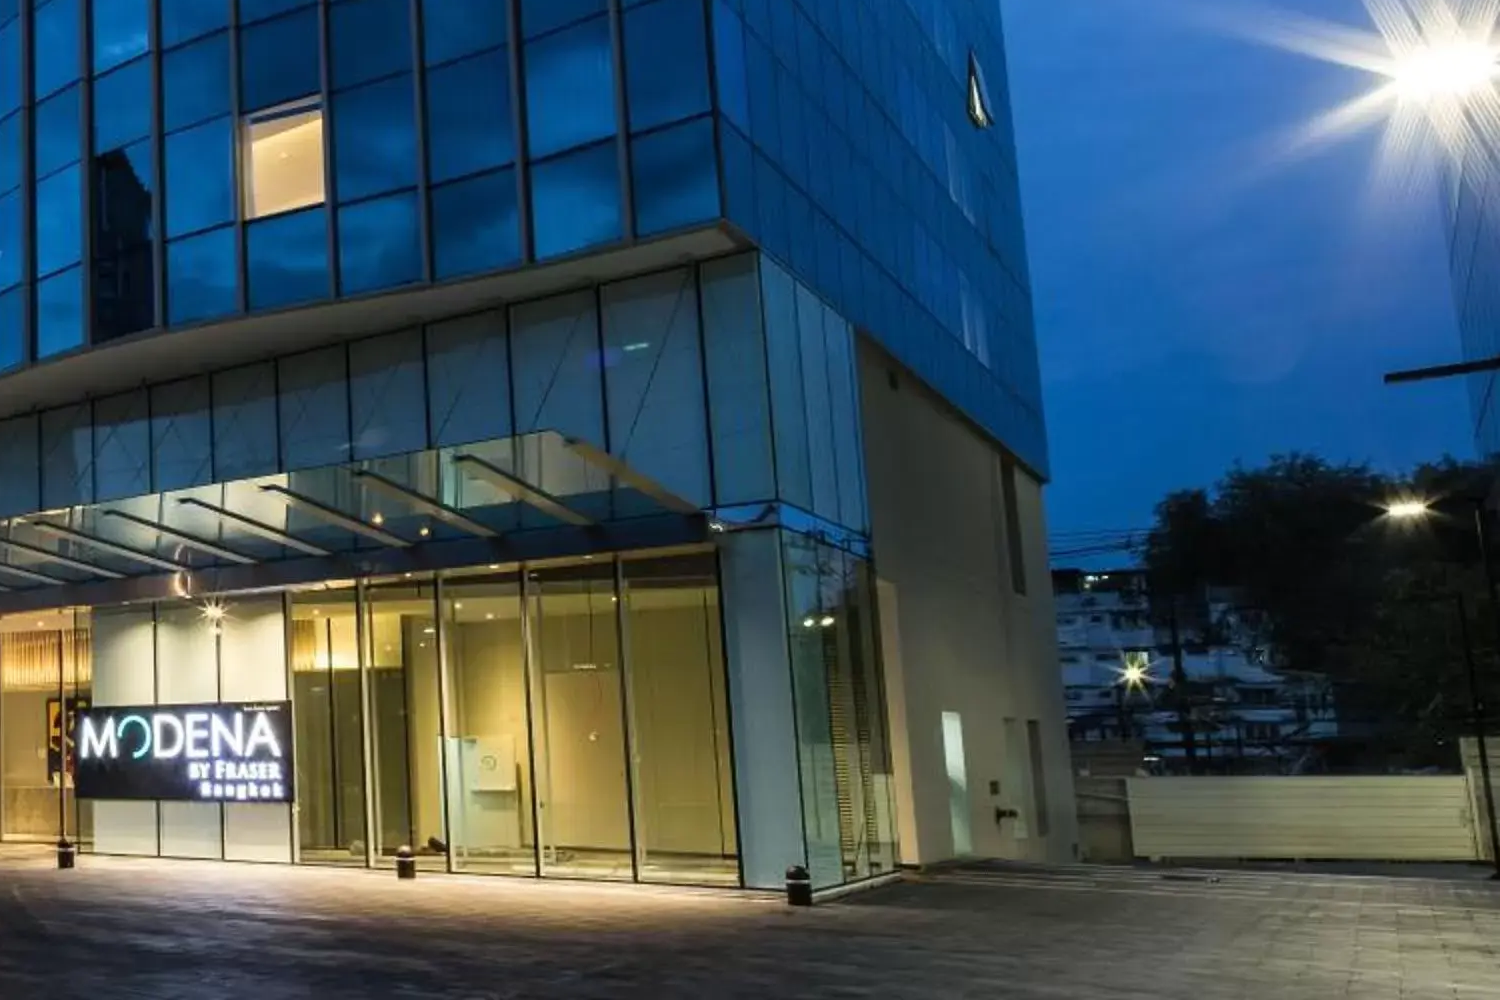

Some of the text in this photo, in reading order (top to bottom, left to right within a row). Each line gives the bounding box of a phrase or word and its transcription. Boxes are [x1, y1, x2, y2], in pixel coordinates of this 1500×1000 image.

[80, 711, 282, 759] MODENA
[189, 760, 282, 779] BY FRASER
